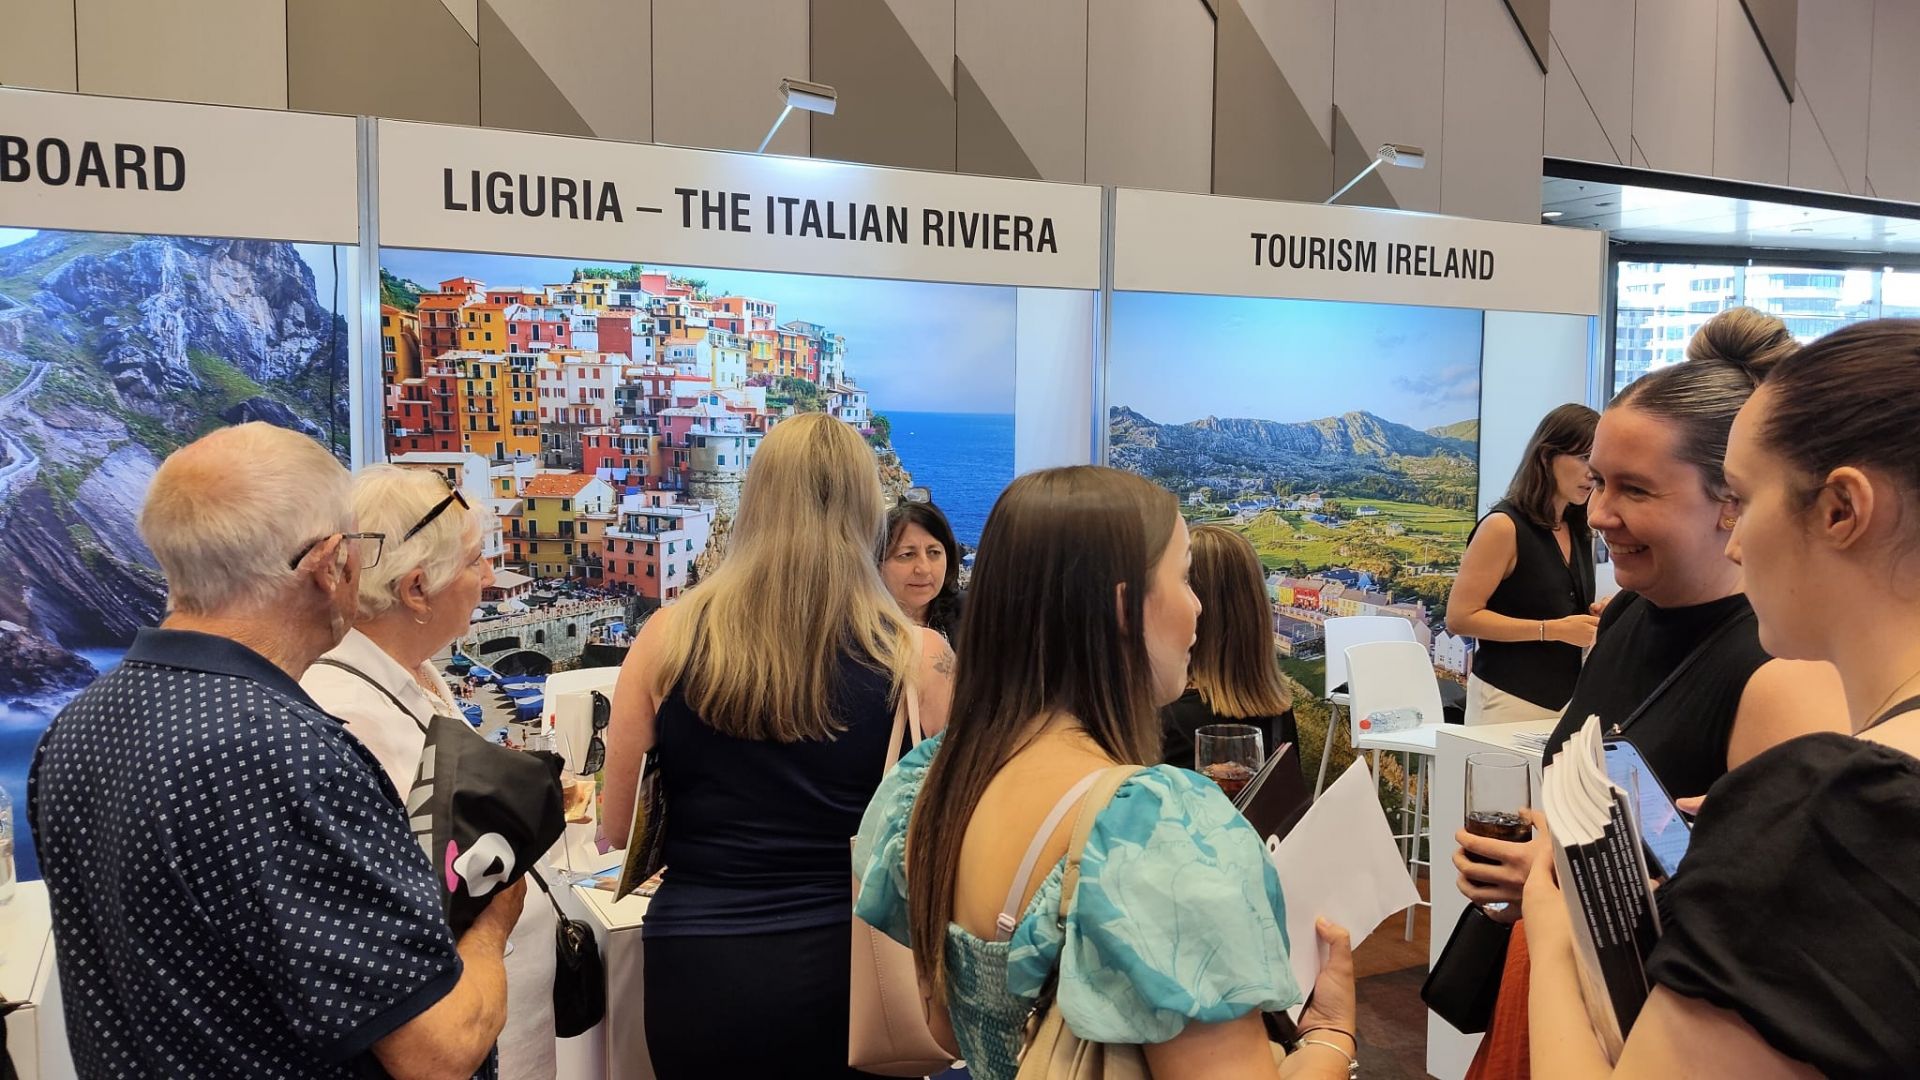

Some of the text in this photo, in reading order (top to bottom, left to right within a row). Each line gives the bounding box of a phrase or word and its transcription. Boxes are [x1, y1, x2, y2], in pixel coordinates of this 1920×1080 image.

[0, 134, 186, 192] BOARD
[443, 167, 624, 223] LIGURIA
[674, 187, 751, 233] THE
[767, 195, 908, 244] ITALIAN
[923, 208, 1058, 255] RIVIERA
[1250, 232, 1494, 281] TOURISM IRELAND
